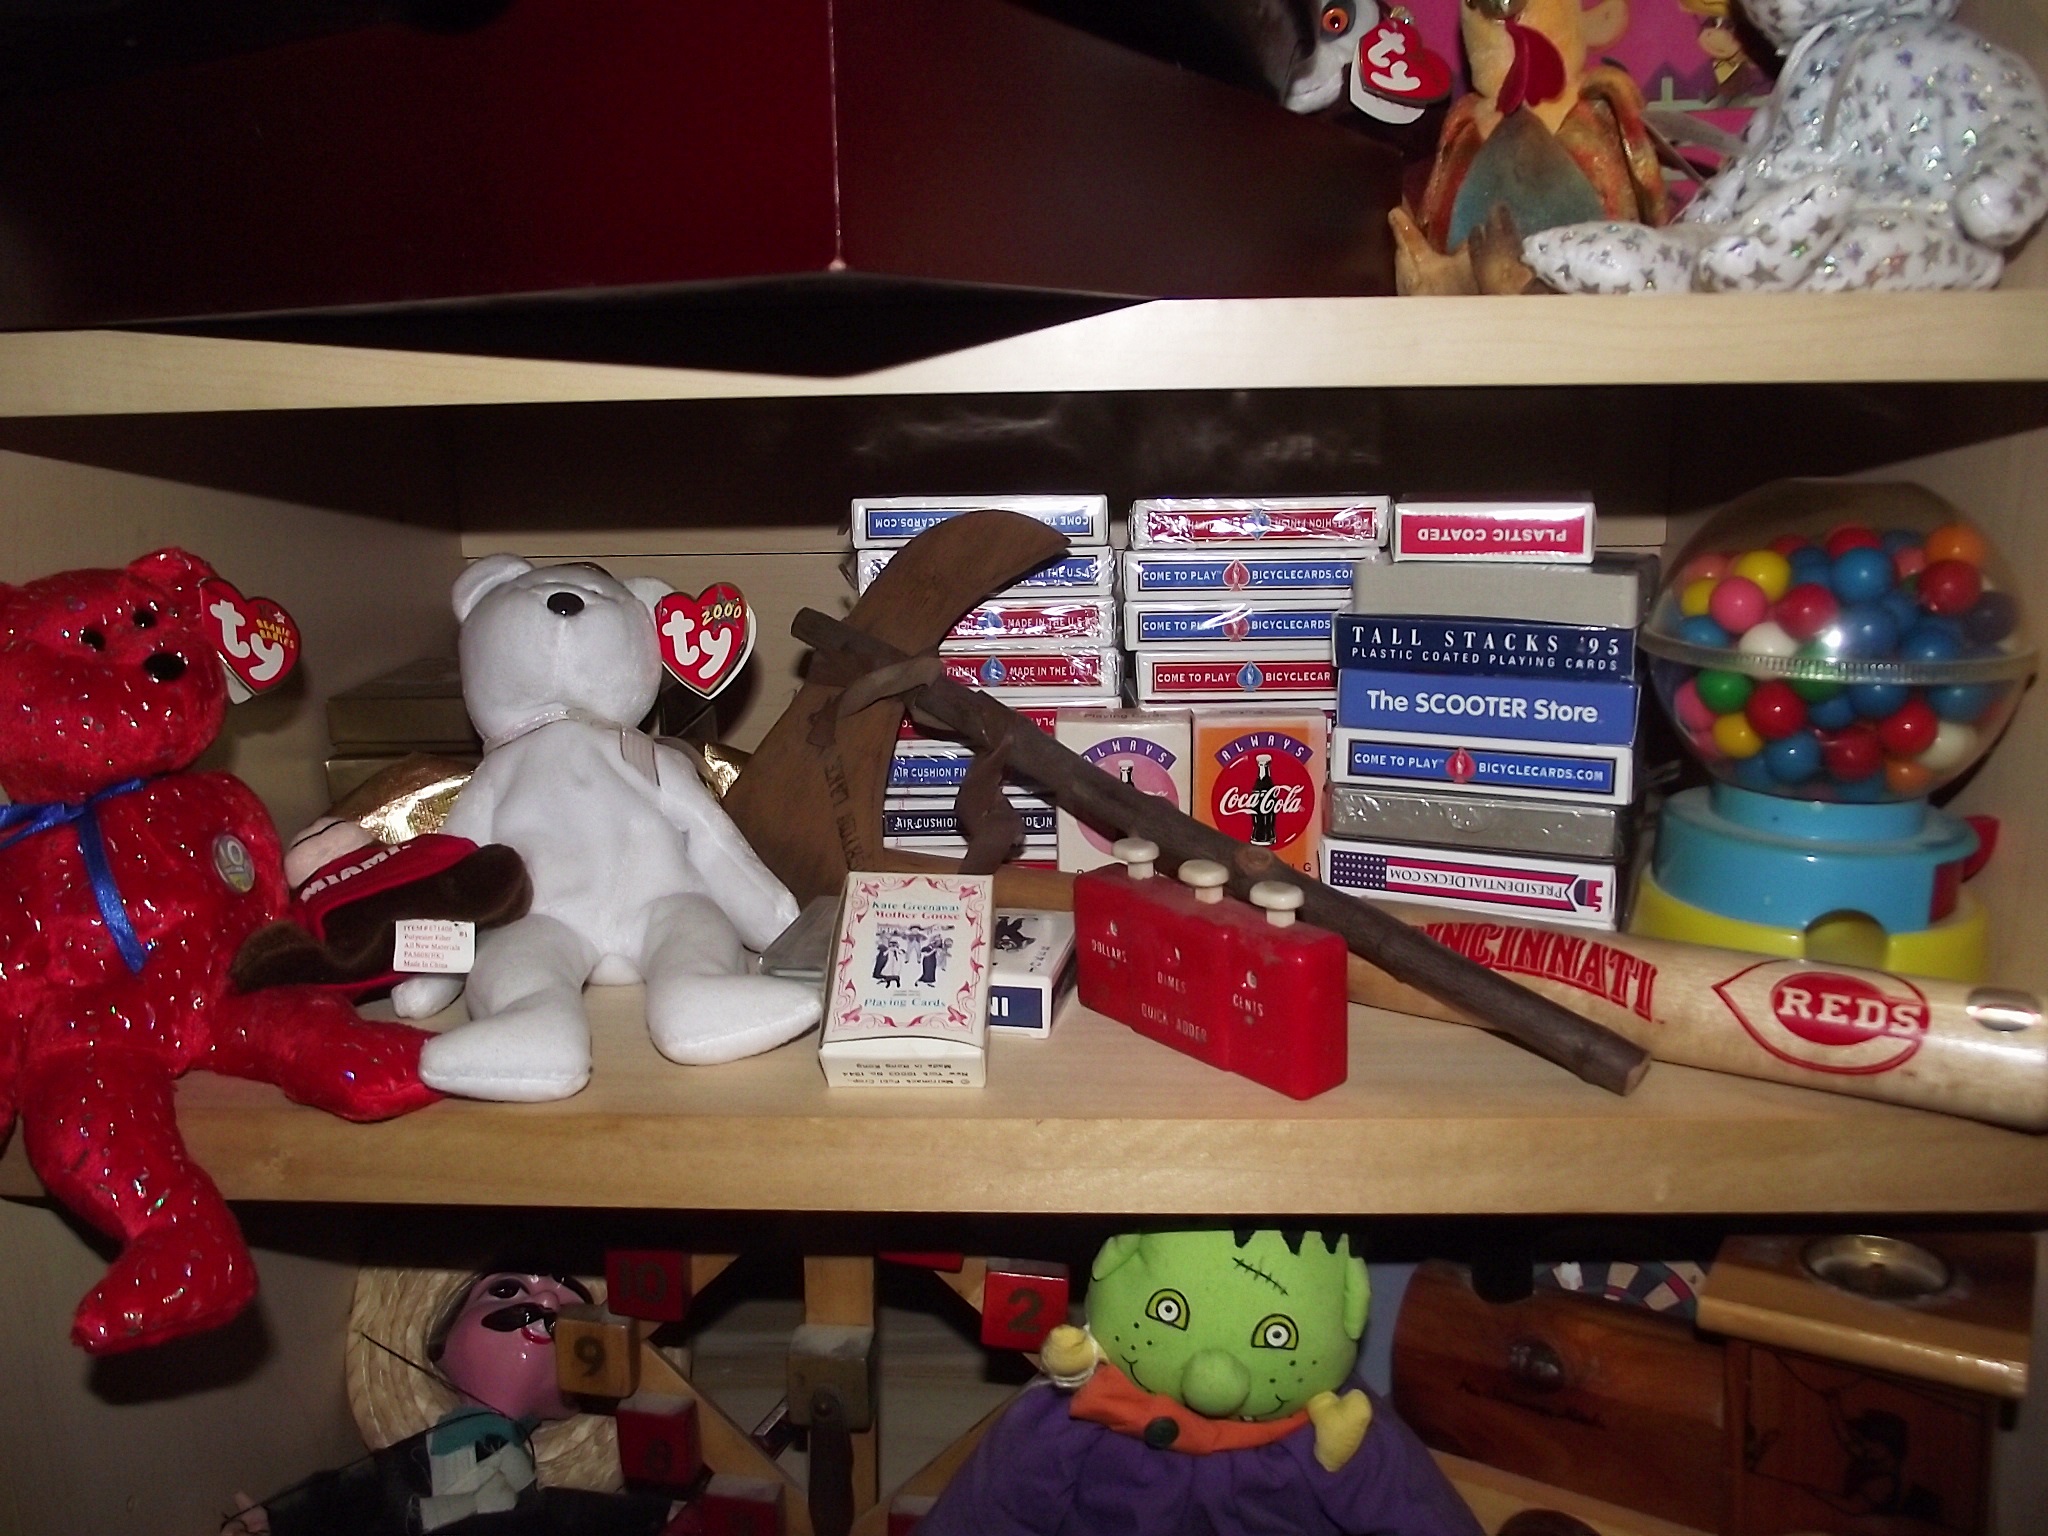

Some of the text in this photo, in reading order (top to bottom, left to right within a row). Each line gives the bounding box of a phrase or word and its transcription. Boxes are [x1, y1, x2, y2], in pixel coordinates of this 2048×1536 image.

[1367, 28, 1421, 91] ty
[1044, 515, 1088, 526] COME TO
[1417, 528, 1568, 542] PLASTIC COATED
[1142, 571, 1172, 581] COME
[1174, 571, 1188, 581] TO
[701, 603, 742, 626] 2000
[1007, 618, 1032, 628] MADE
[1036, 618, 1045, 628] IN
[1049, 618, 1065, 628] THE
[1142, 621, 1172, 631] COME
[1174, 621, 1188, 631] TO
[209, 599, 285, 682] ty
[662, 610, 732, 680] ty
[1352, 626, 1620, 656] TALL STACKS '95
[1352, 647, 1618, 671] PLASTIC COATED PLAYING CARDS
[1009, 667, 1035, 677] MADE
[1037, 667, 1047, 676] IN
[1050, 666, 1066, 676] THE
[1157, 674, 1187, 683] COME
[1189, 674, 1202, 683] TO
[1367, 689, 1599, 724] The SCOOTER Store
[1221, 734, 1305, 761] ALWAYS
[893, 768, 909, 778] AIR
[911, 767, 951, 778] CUSHION
[1354, 752, 1387, 765] COME
[1390, 755, 1405, 766] TO
[1478, 762, 1604, 782] BICYCLECARDS.COM
[1219, 785, 1305, 816] Coca-Cola
[872, 901, 898, 909] Kate
[875, 910, 960, 920] Mother Goose
[1091, 939, 1127, 963] DOLLARS
[1157, 971, 1187, 995] DIMES
[864, 998, 946, 1008] Playing Cards
[1232, 993, 1264, 1018] CENTS
[1778, 987, 1924, 1039] REDS
[1141, 1003, 1208, 1043] QUICK ADDER
[617, 1257, 667, 1303] 10
[1007, 1287, 1044, 1334] 2
[573, 1335, 606, 1378] 9
